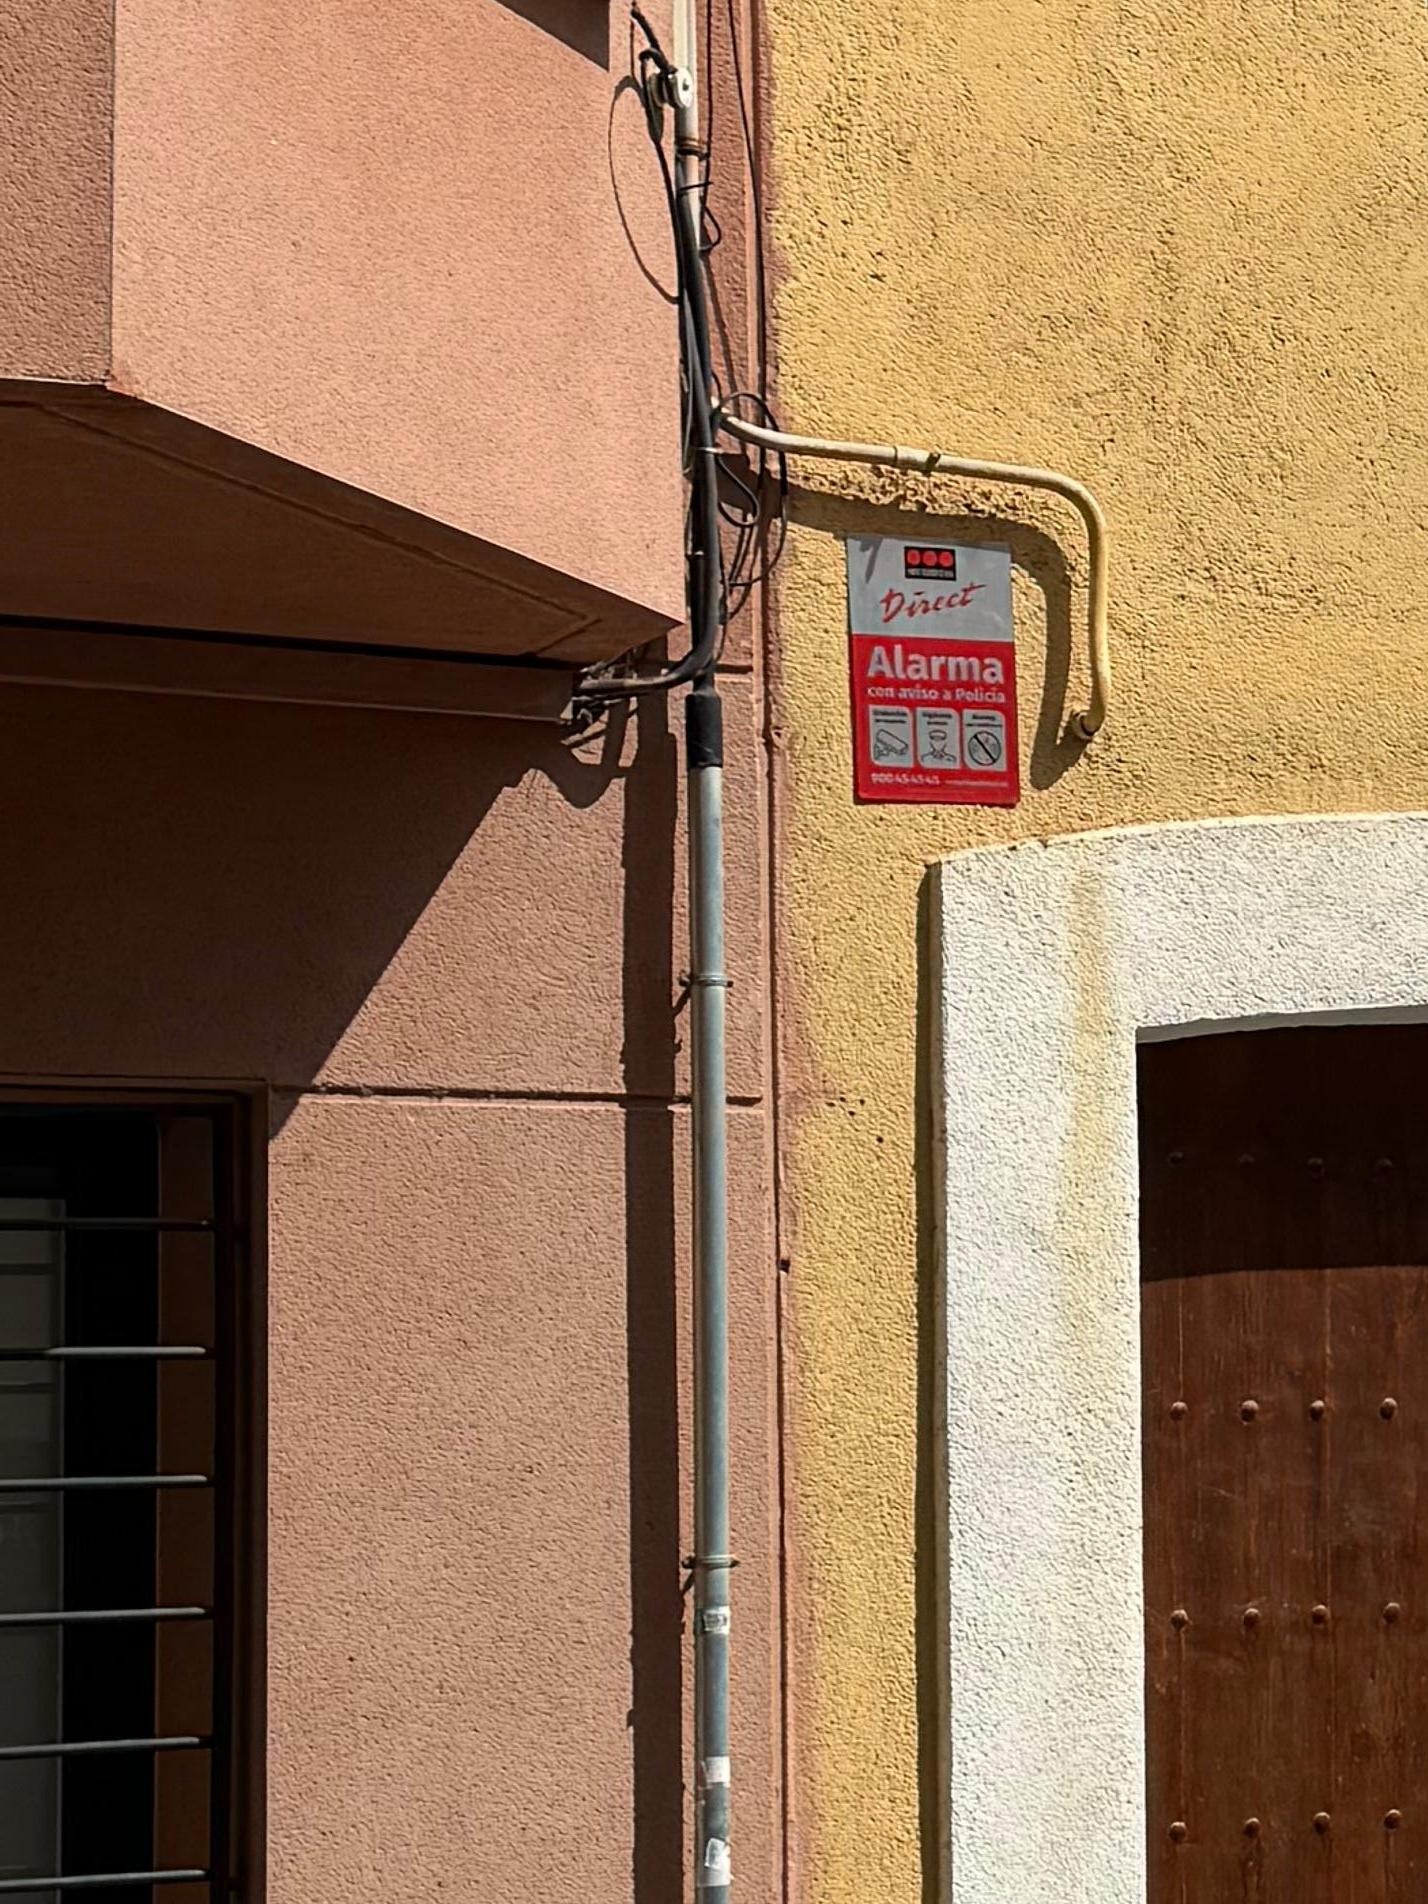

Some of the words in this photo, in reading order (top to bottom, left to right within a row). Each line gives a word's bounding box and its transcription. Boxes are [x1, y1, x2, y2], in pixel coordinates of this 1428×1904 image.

[880, 583, 986, 623] Direct
[867, 644, 1004, 684] Alarma
[867, 687, 895, 698] con
[898, 683, 939, 700] aviso
[943, 689, 952, 701] a
